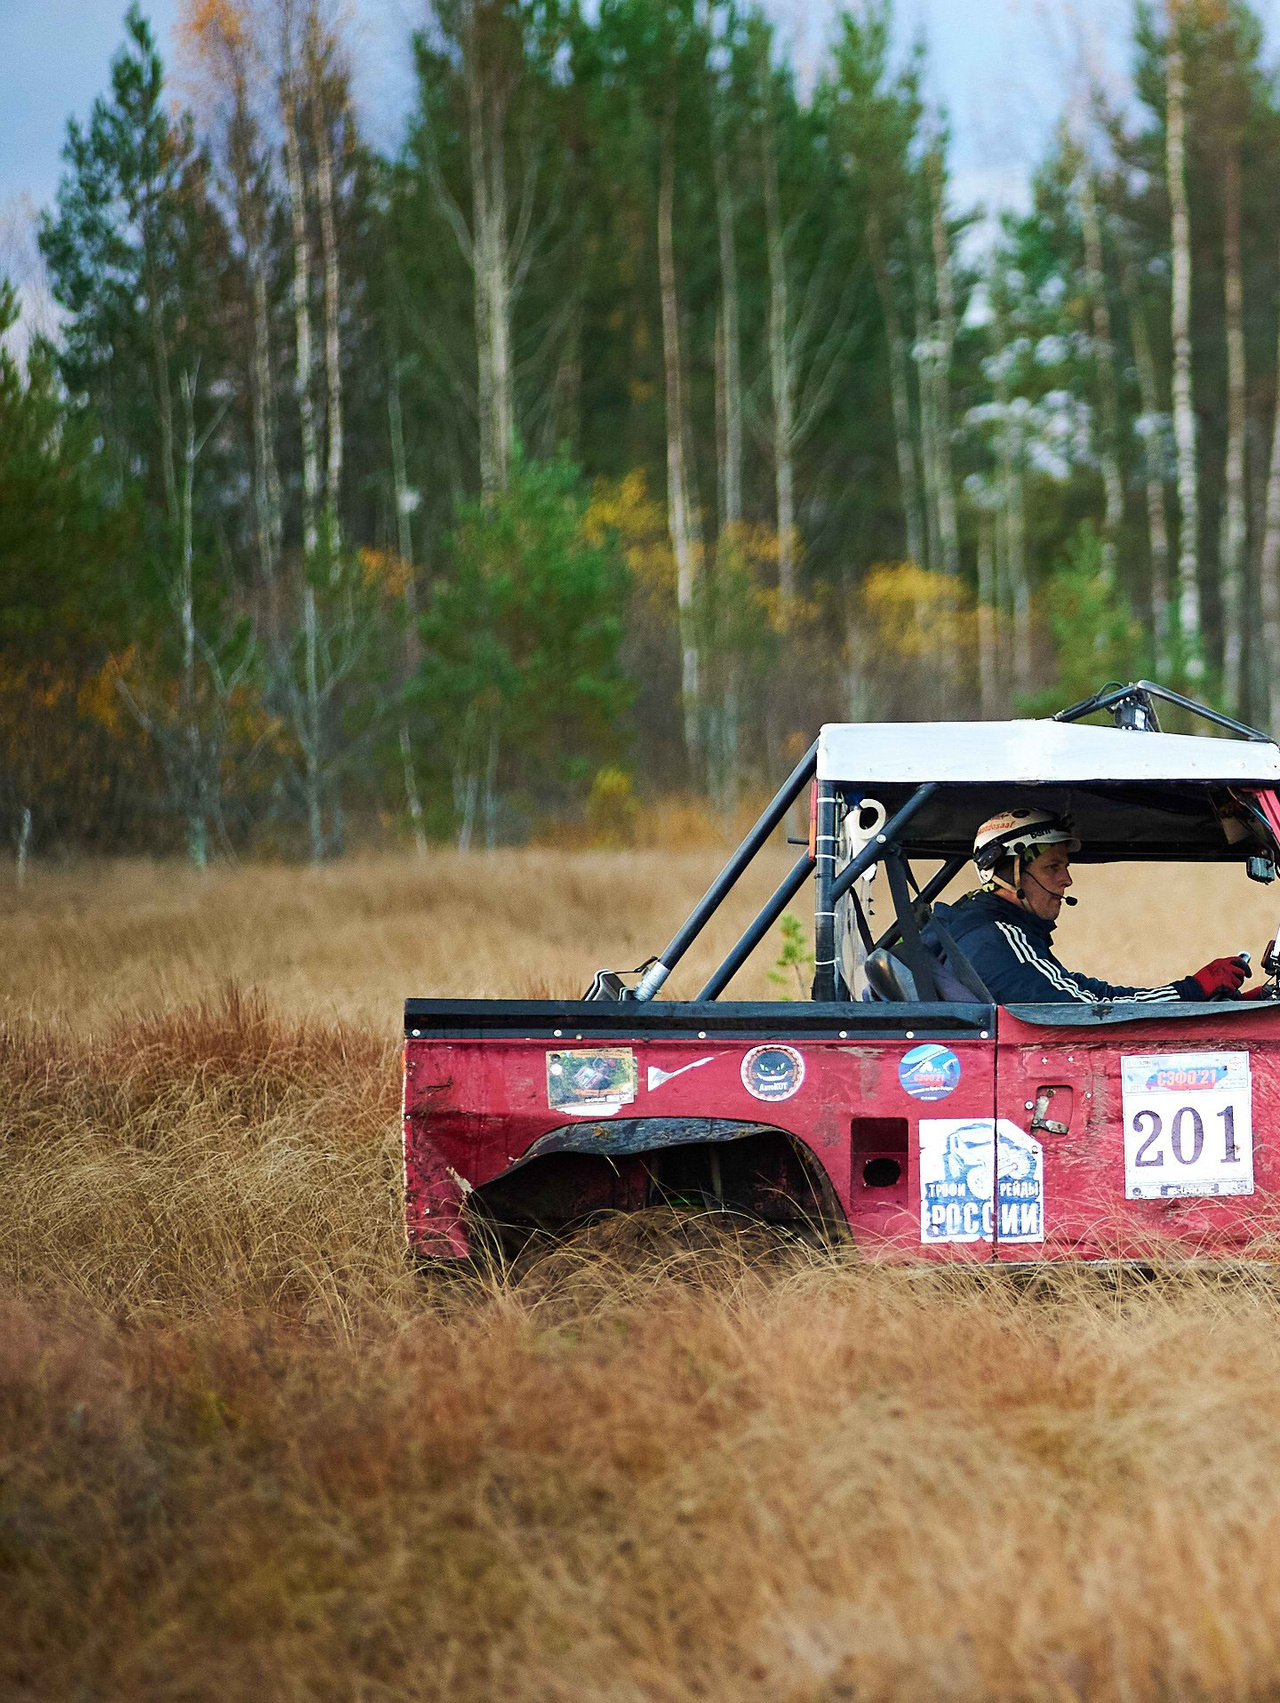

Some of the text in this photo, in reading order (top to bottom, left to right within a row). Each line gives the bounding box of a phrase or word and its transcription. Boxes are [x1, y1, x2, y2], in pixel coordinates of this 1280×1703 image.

[1157, 1068, 1217, 1087] СЗФО'21
[1132, 1105, 1241, 1168] 201
[928, 1181, 1039, 1198] ТРОФИ РЕЙДЫ
[931, 1201, 1039, 1235] РОССИИ
